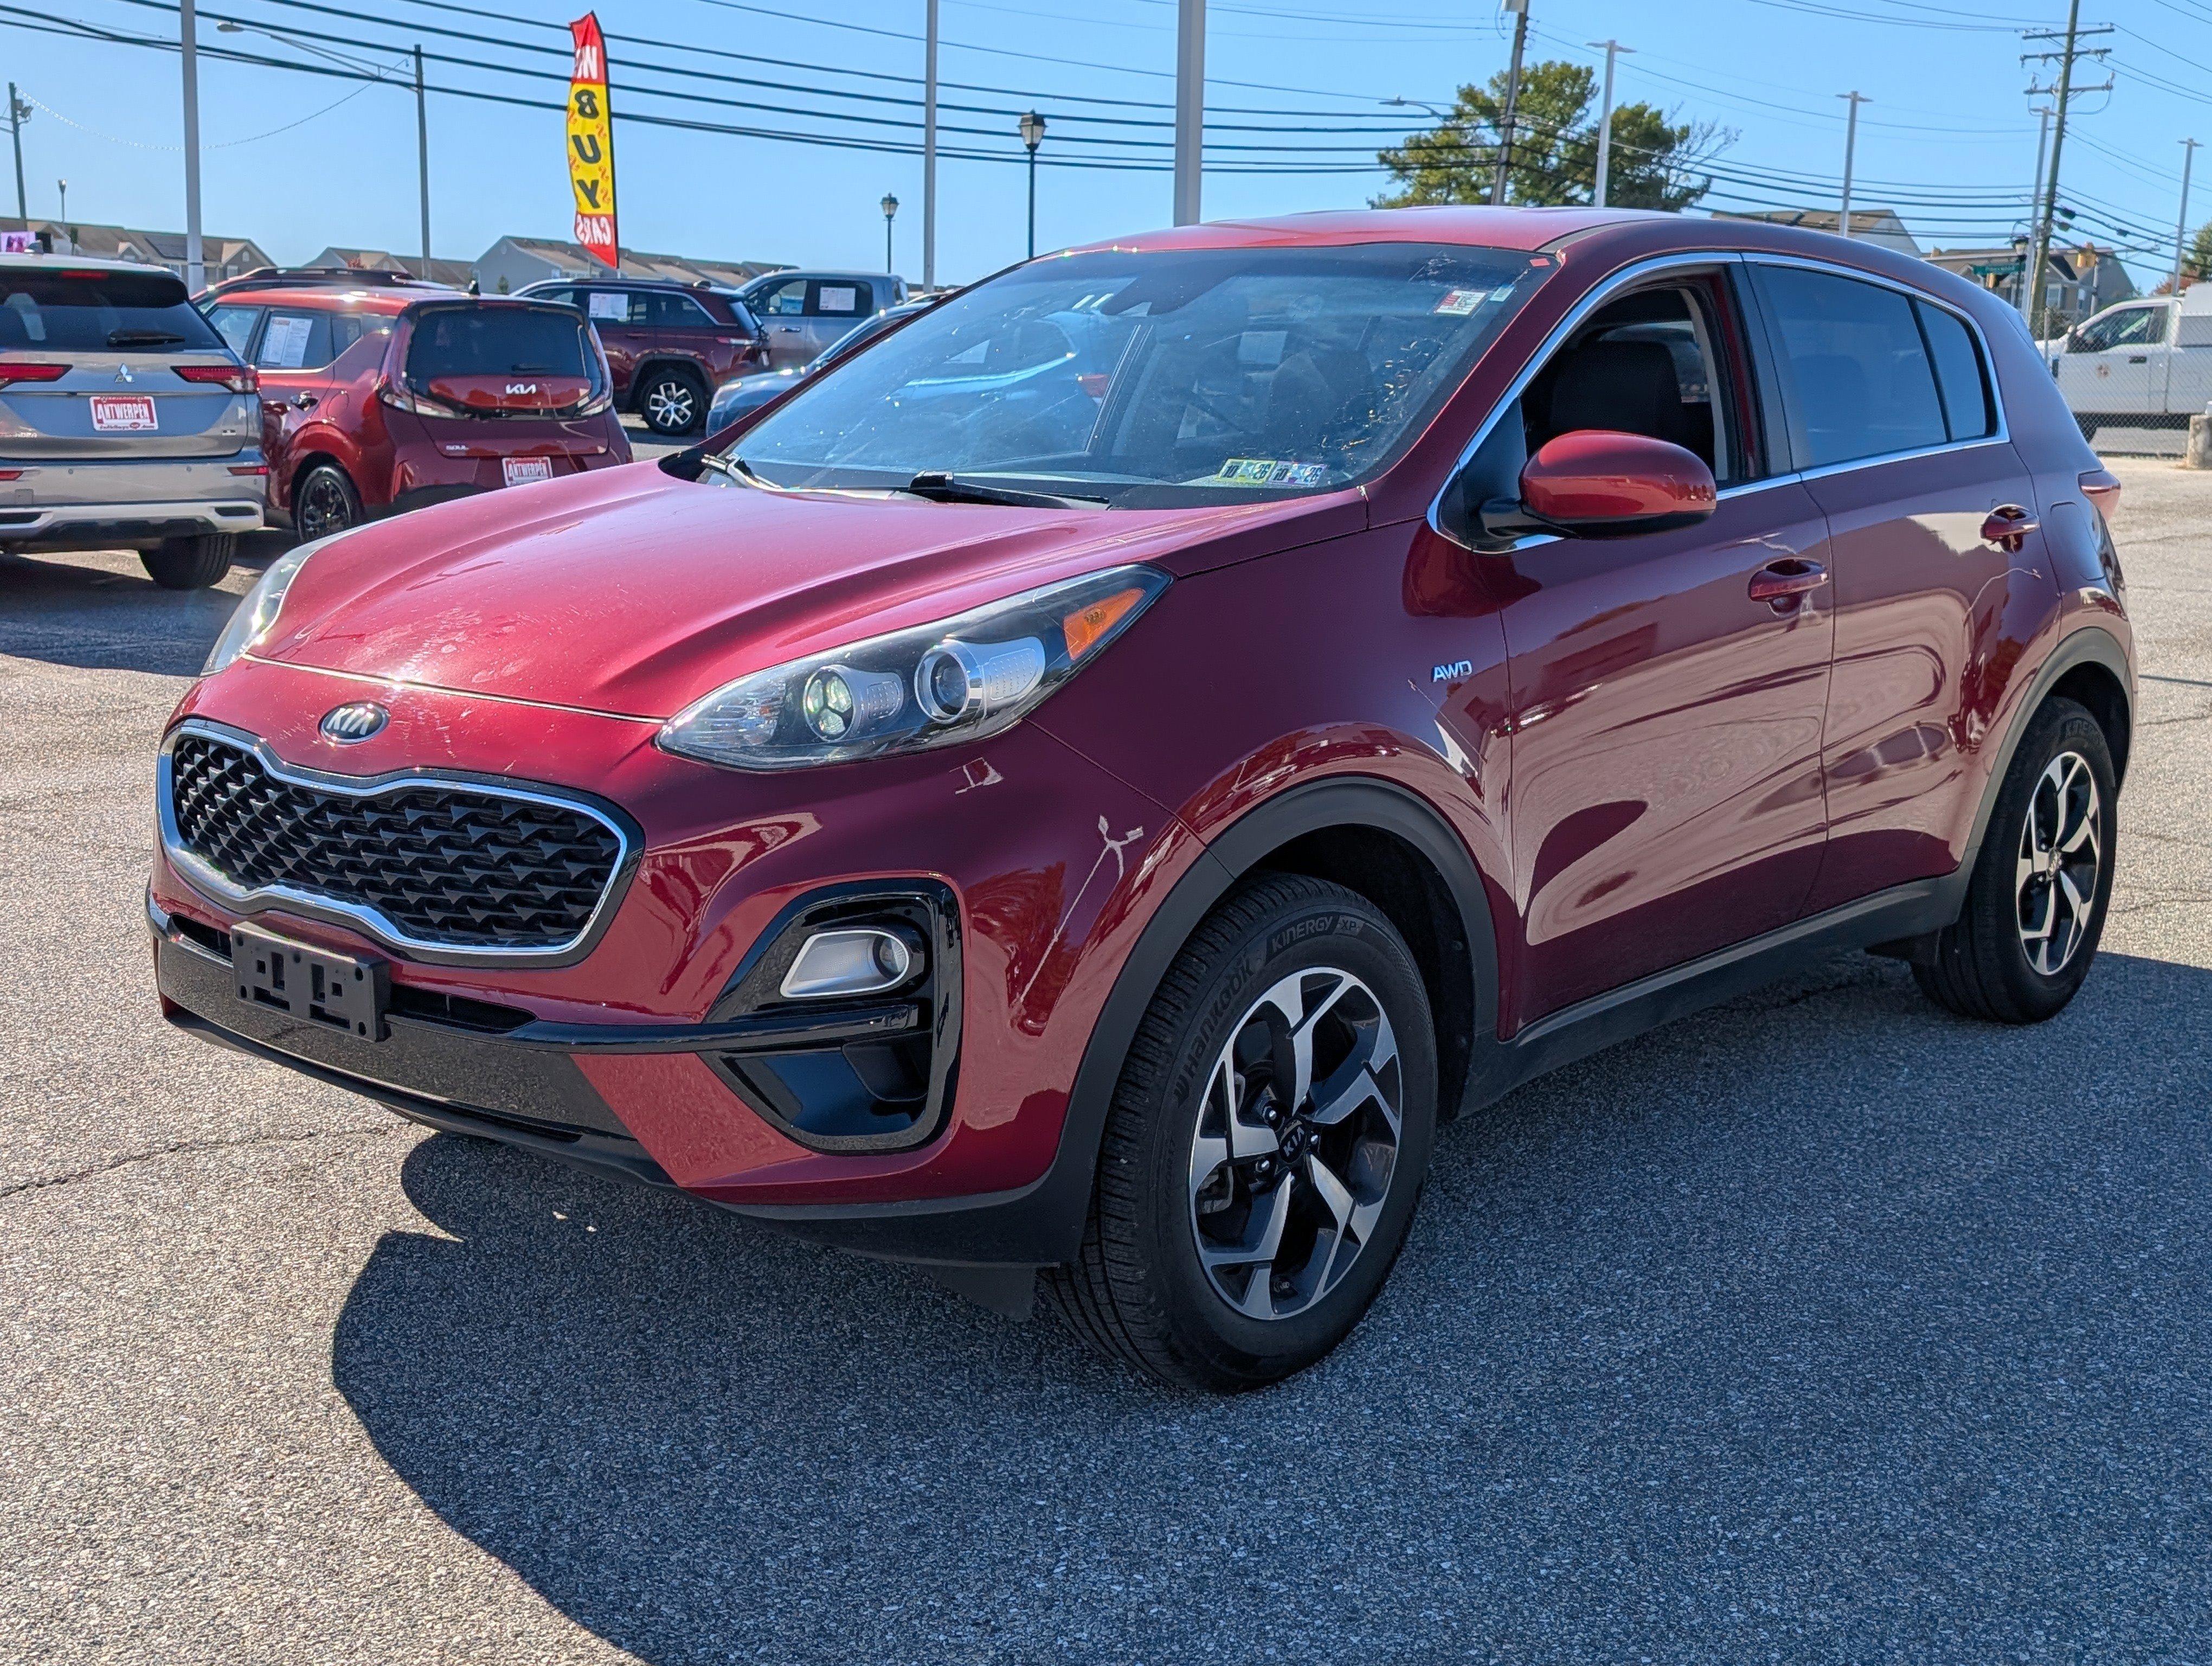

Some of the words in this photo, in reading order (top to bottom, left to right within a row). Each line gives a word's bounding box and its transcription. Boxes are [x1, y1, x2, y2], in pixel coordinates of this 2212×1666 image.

[505, 383, 536, 394] KIA
[98, 403, 150, 420] ANTWERPEN
[1223, 464, 1240, 478] 10
[1252, 464, 1271, 479] 26
[1273, 467, 1289, 481] 10
[1303, 467, 1323, 482] 26
[1432, 660, 1472, 683] AWD
[326, 707, 375, 735] KIA
[1272, 916, 1333, 953] KINERGY
[1283, 1126, 1305, 1157] KIA
